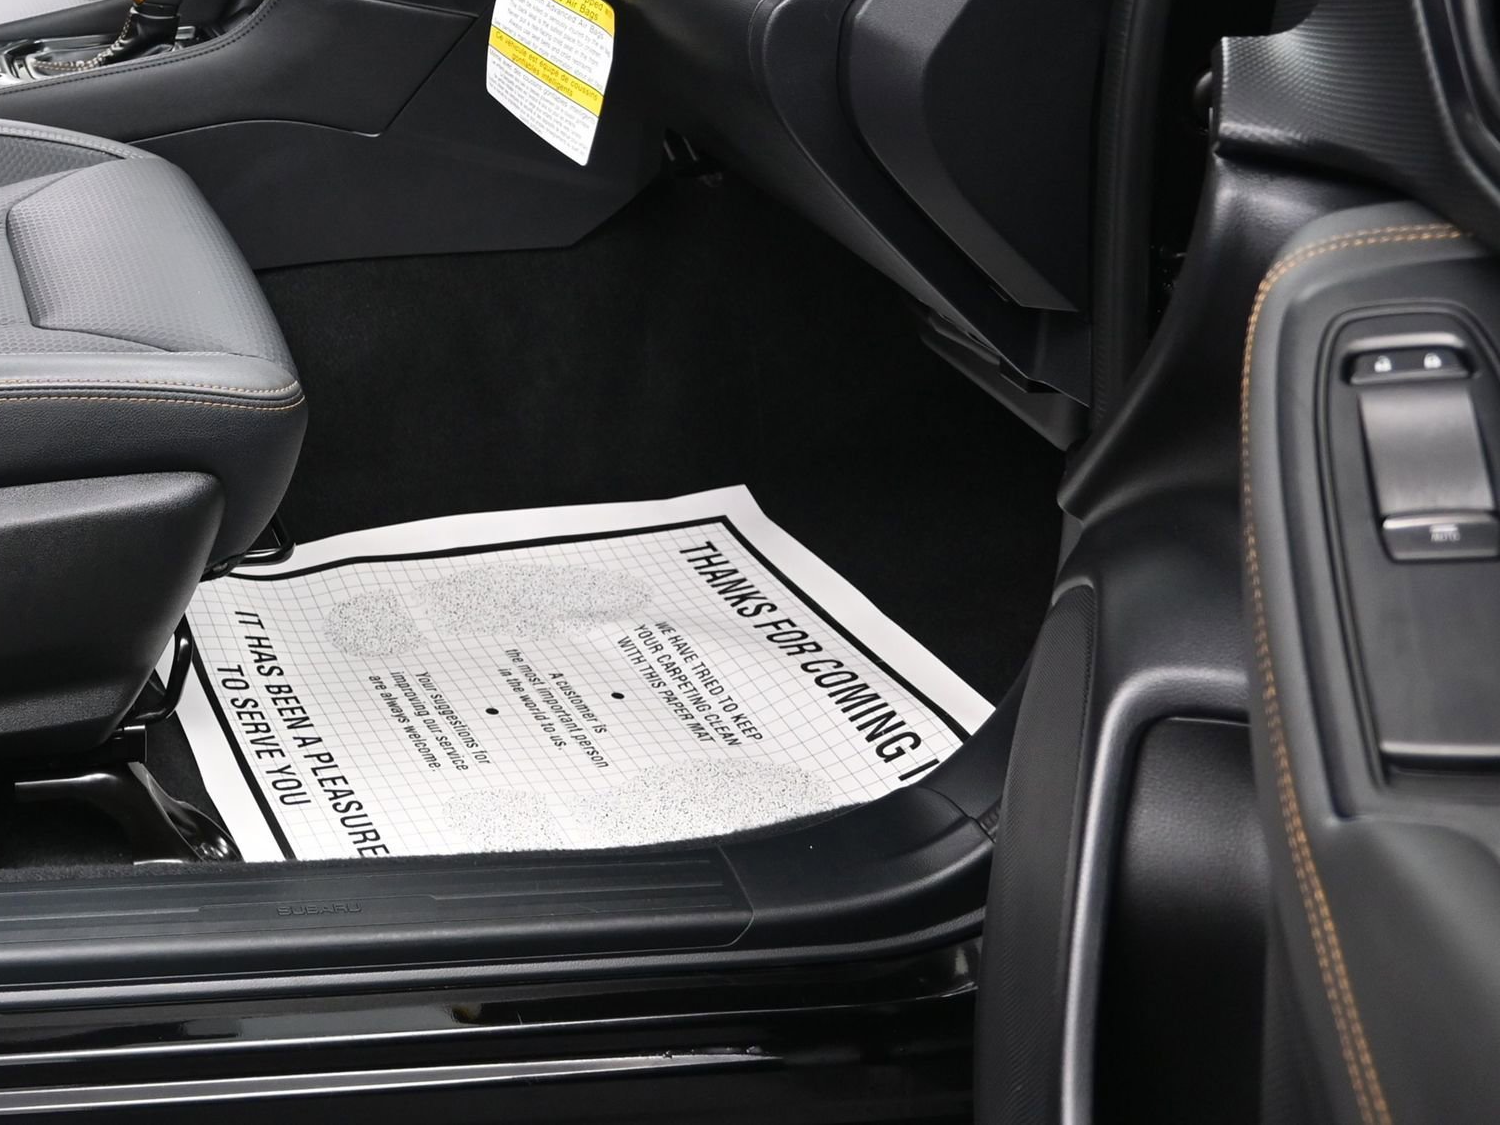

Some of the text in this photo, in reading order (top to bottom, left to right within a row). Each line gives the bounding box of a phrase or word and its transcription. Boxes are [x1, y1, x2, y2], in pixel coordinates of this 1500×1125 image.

[579, 4, 598, 21] Bags
[548, 672, 607, 734] A customer is
[617, 635, 716, 743] WITH THIS PAPER MAT
[634, 624, 742, 746] YOUR CARPETING CLEAN
[655, 621, 764, 741] WE HAVE TRIED TO KEEP
[679, 541, 778, 618] THANKS
[753, 618, 824, 657] FOR
[800, 658, 922, 764] COMING
[217, 664, 311, 806] TO SERVE YOU
[235, 611, 390, 858] IT HAS BEEN A PLEASURE
[368, 675, 441, 772] are always welcome.
[390, 671, 469, 771] improving our service
[415, 671, 491, 764] Your suggestions for
[498, 668, 567, 750] in the world to us.
[505, 648, 609, 768] the most important person
[276, 902, 363, 916] SUBARU
